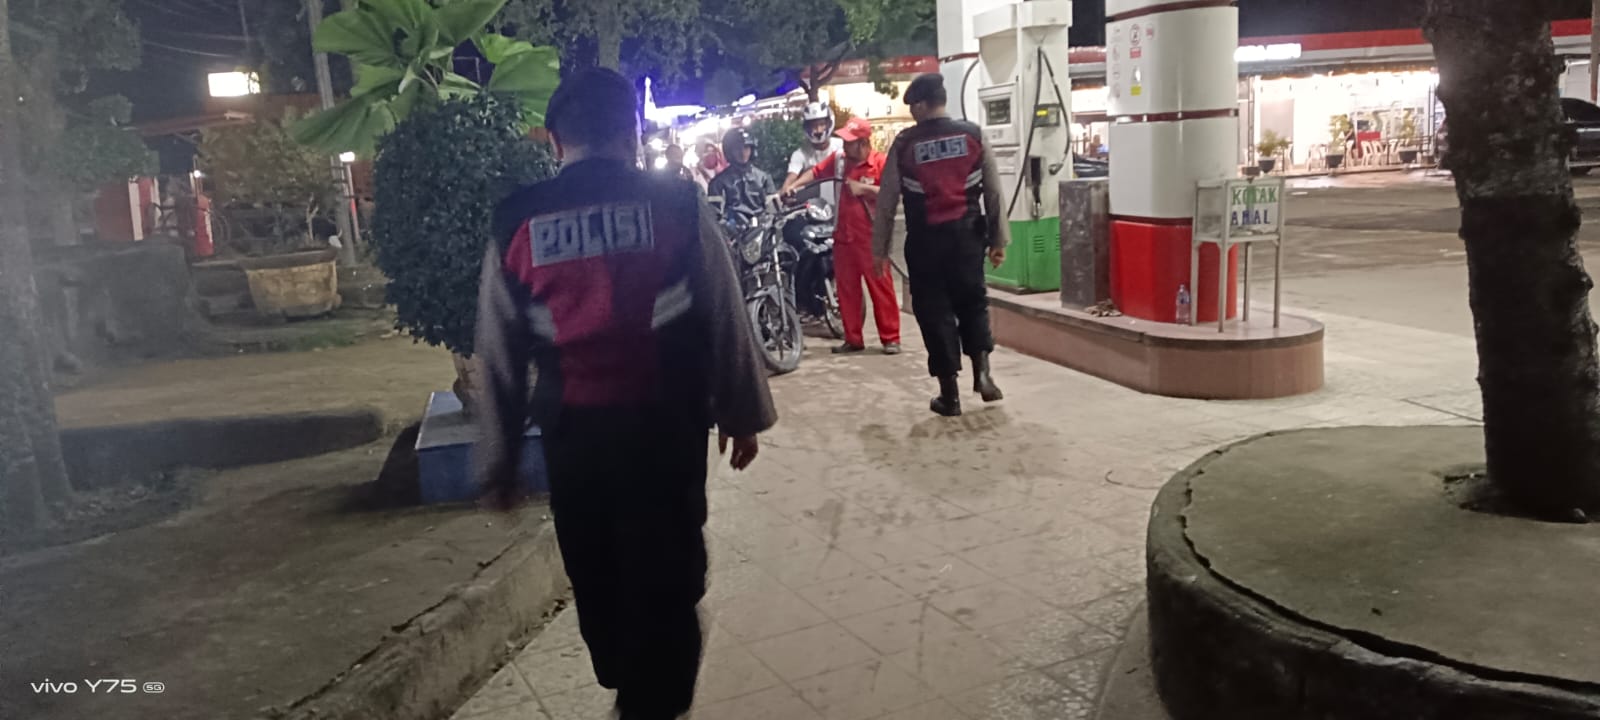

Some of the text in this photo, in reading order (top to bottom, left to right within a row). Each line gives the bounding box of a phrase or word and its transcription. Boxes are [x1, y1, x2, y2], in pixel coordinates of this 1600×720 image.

[916, 136, 967, 163] POLISI
[1231, 187, 1277, 206] KOTAK
[1231, 209, 1271, 226] AMAL
[531, 204, 649, 264] POLISI
